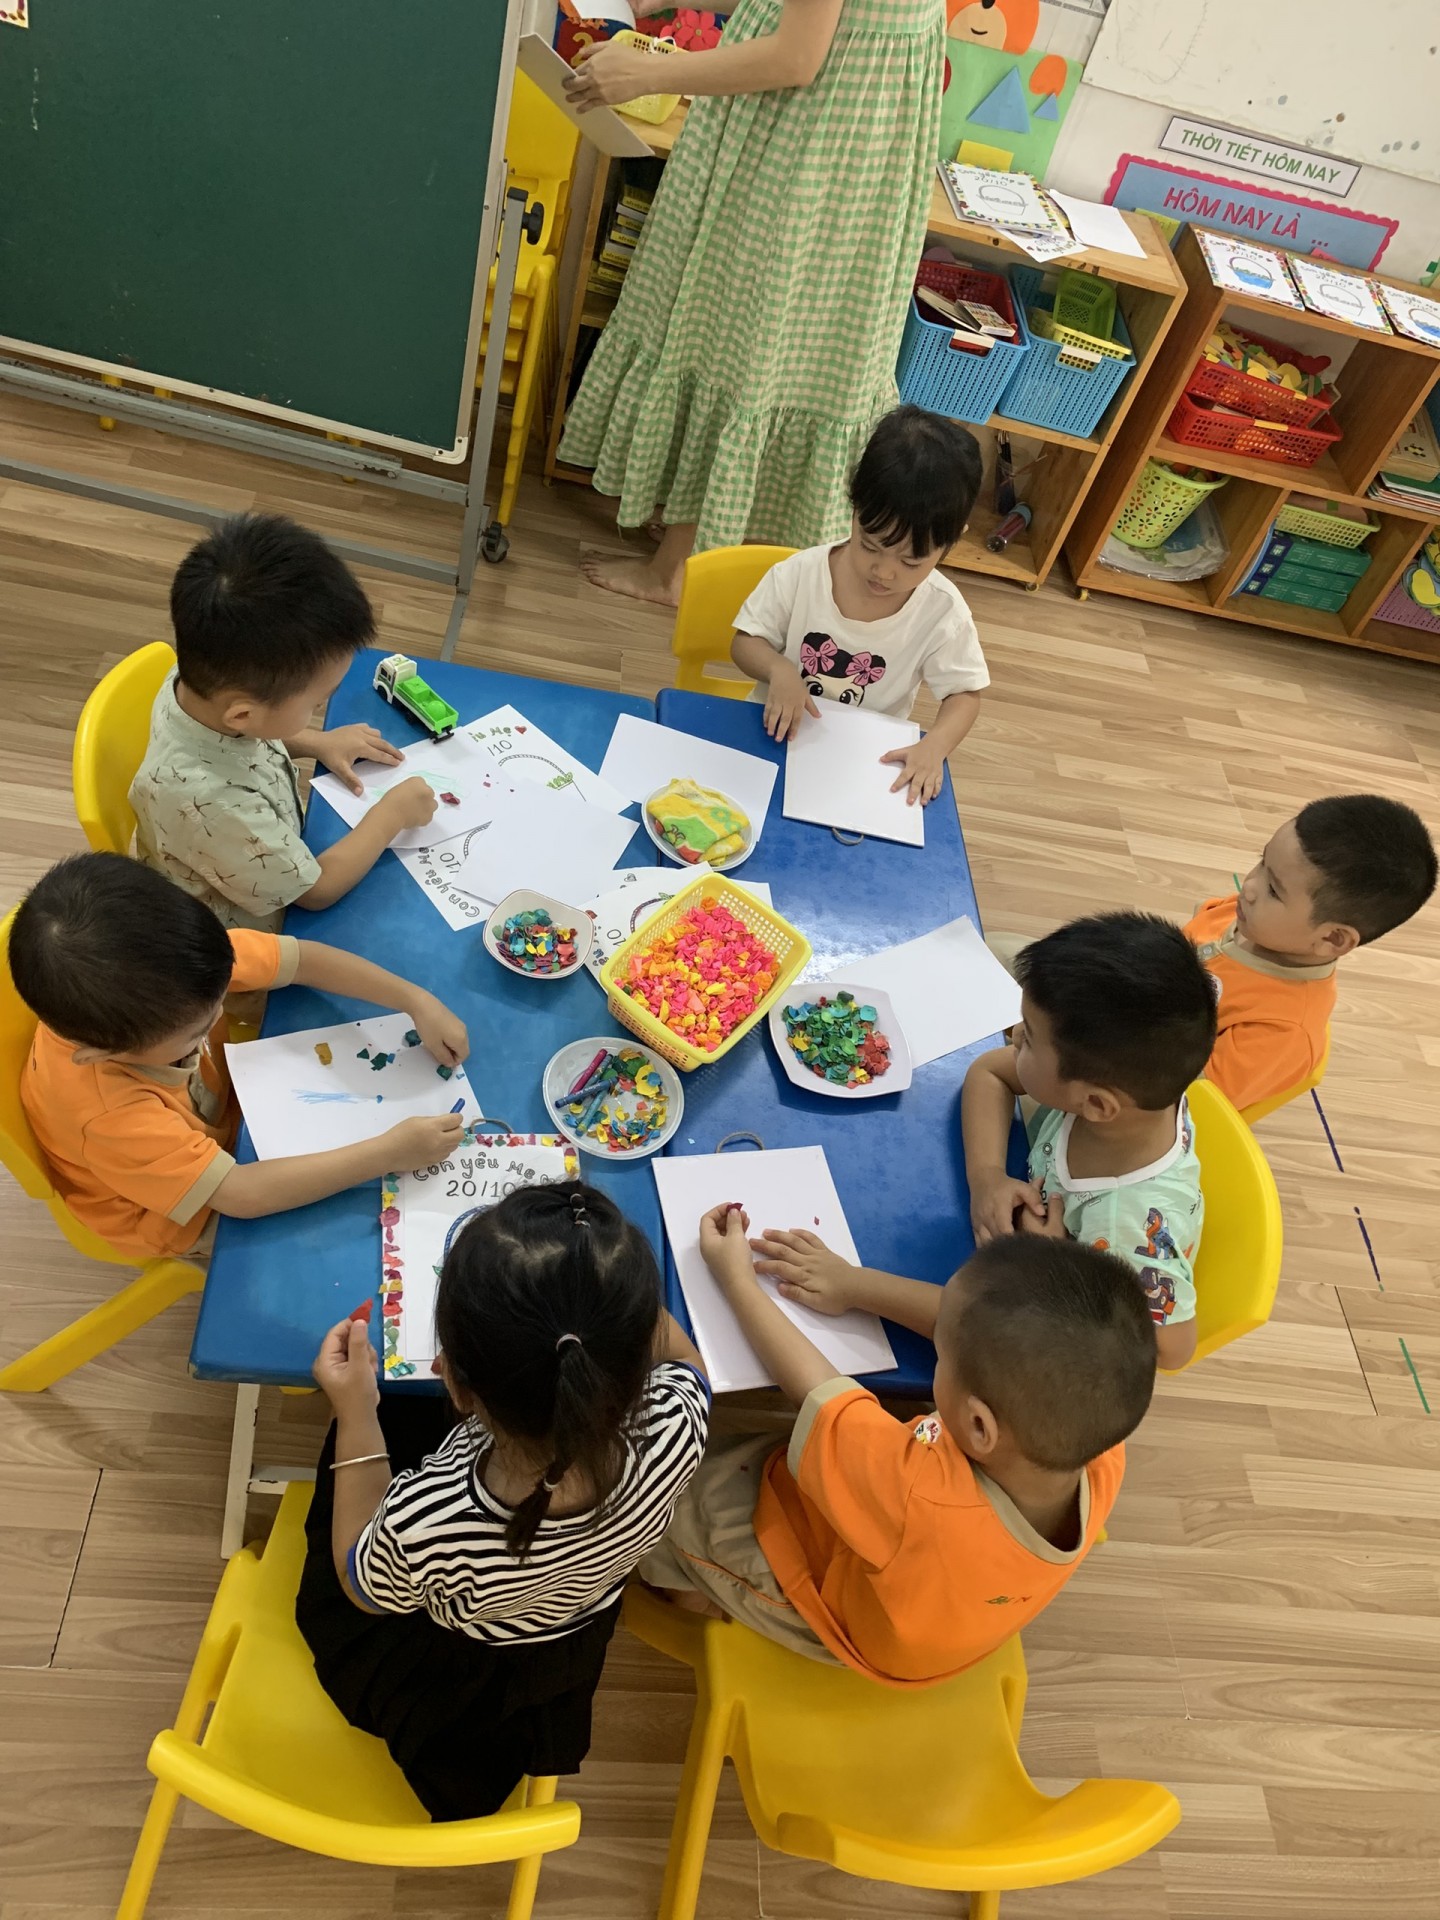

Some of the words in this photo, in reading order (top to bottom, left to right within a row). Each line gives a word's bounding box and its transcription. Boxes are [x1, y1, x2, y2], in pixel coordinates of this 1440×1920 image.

[1180, 129, 1223, 153] THỜI
[1225, 141, 1262, 163] TIẾT
[1262, 152, 1302, 174] HÔM
[1302, 163, 1341, 184] NAY
[1163, 187, 1221, 218] HÔM
[1222, 202, 1272, 231] NAY
[1271, 213, 1301, 239] LÀ
[487, 740, 512, 757] /10
[424, 869, 452, 894] yêu
[448, 893, 480, 918] Con
[460, 1152, 500, 1179] yêu
[446, 1180, 516, 1198] 20/10
